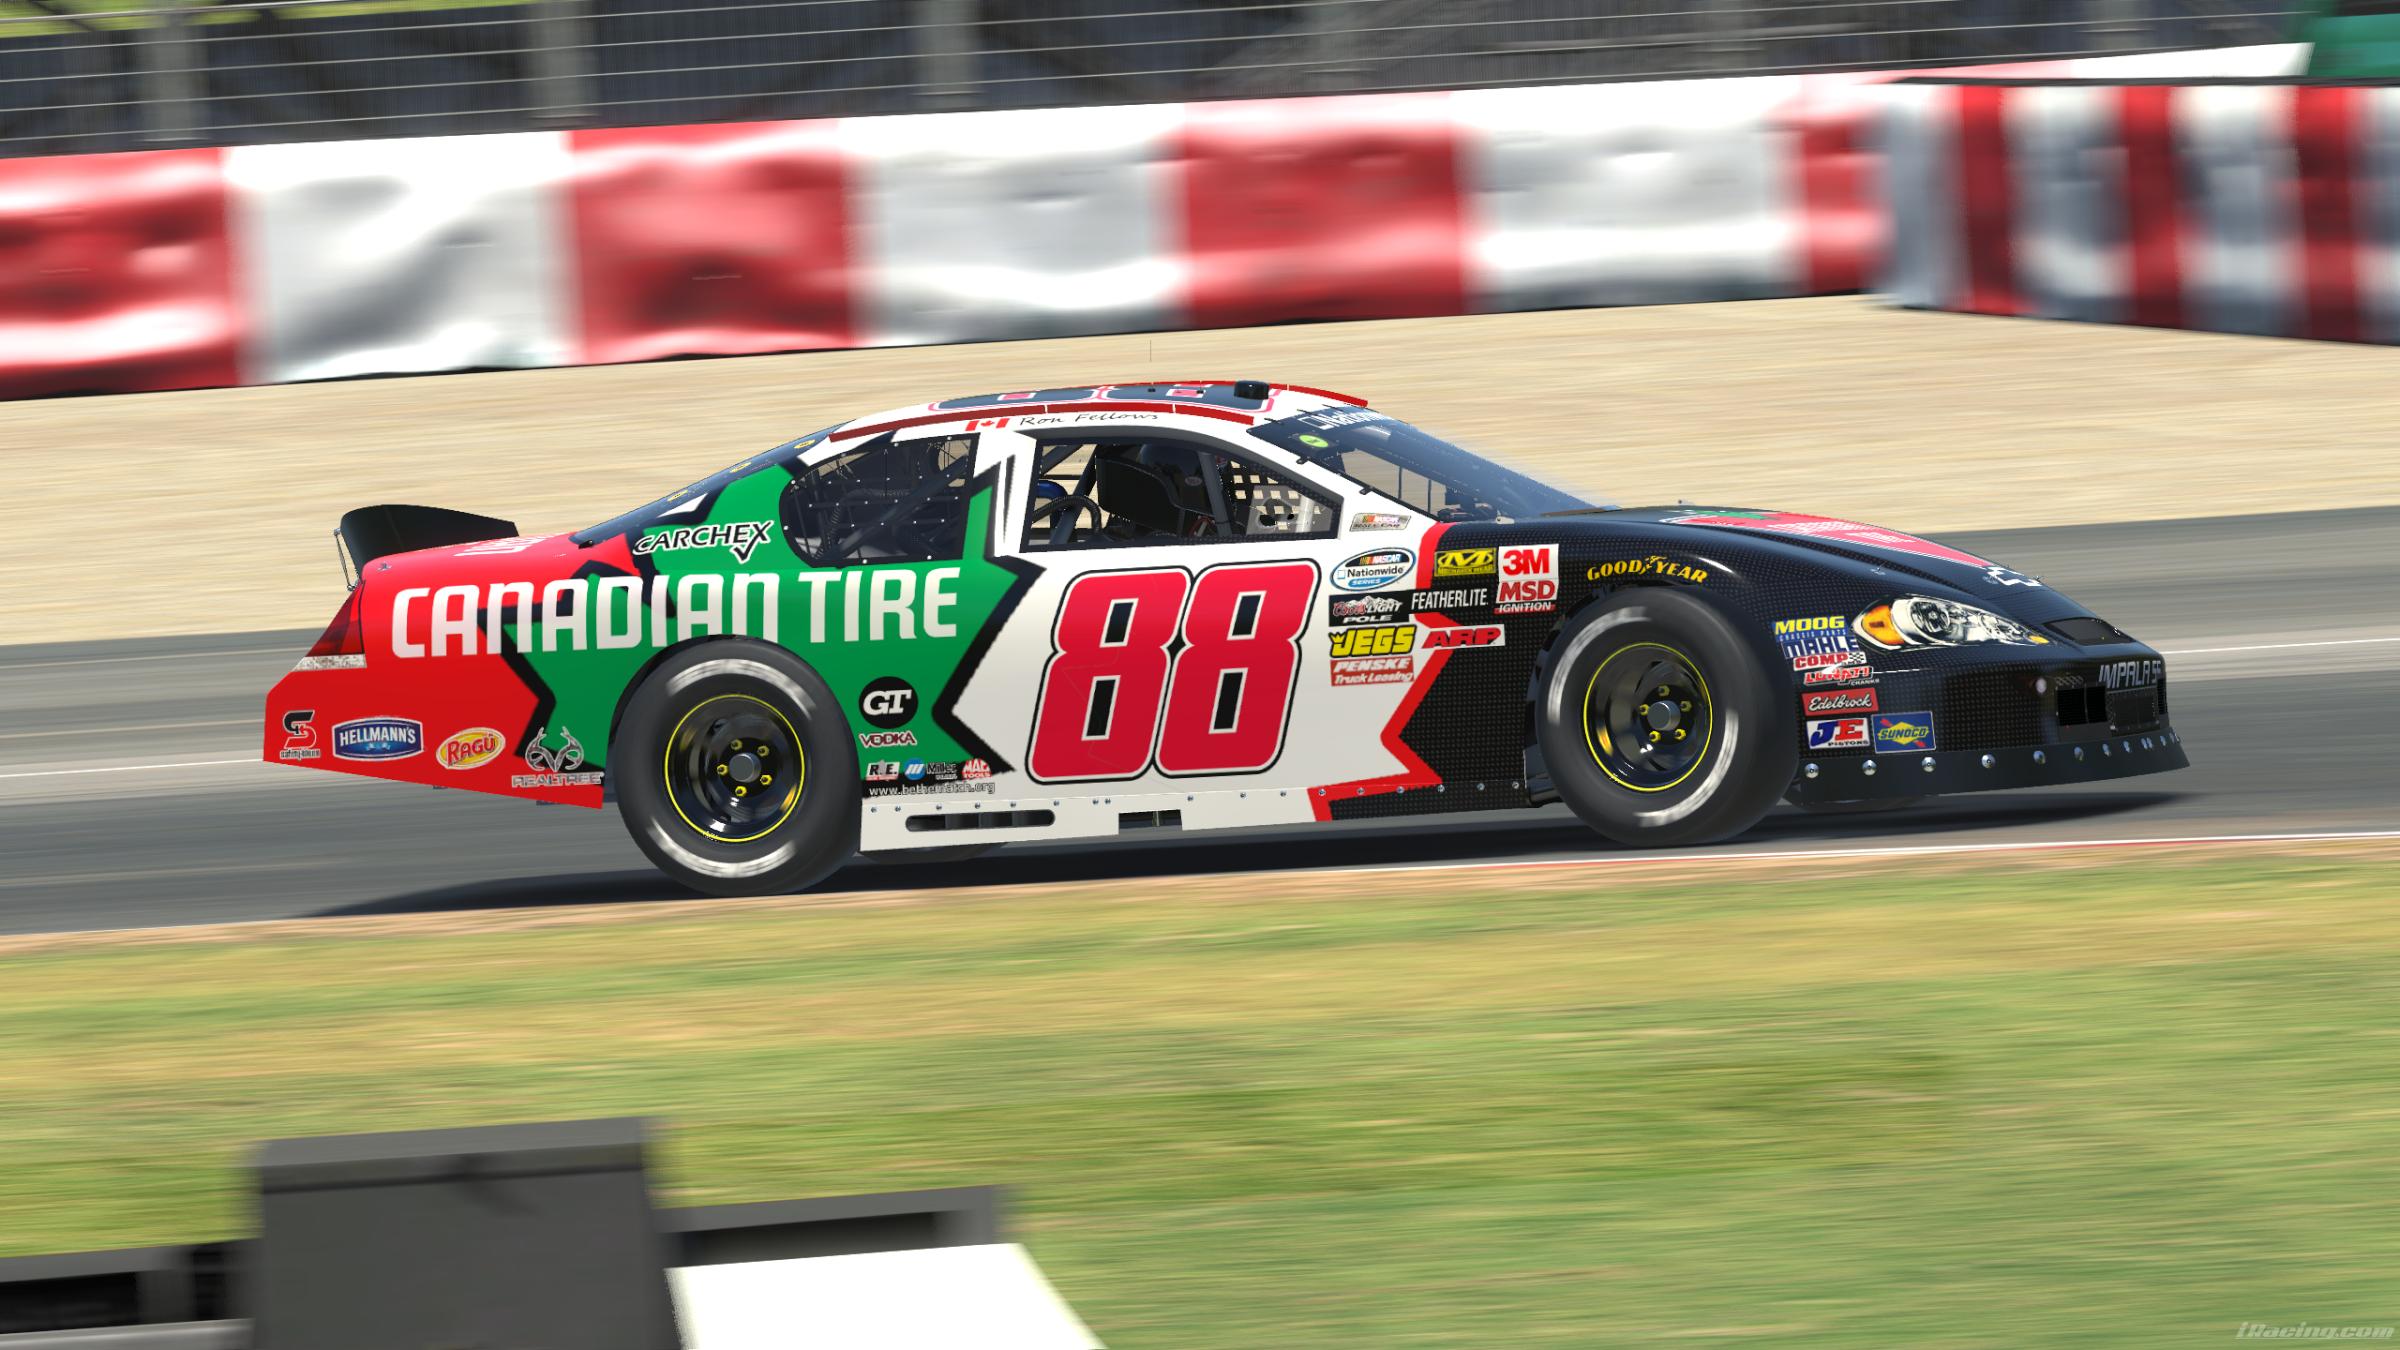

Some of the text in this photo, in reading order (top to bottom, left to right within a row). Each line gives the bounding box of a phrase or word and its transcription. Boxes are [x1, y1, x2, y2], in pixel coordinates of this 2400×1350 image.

[1019, 409, 1159, 427] Ron Fellows
[632, 520, 773, 563] CARCHEX
[1372, 553, 1402, 564] NASCAR
[1503, 548, 1550, 576] 3M
[1347, 566, 1404, 578] Nationwide
[1500, 580, 1555, 602] MSD
[391, 567, 961, 660] CANADIAN TIRE
[1500, 602, 1551, 613] IGNITION
[1343, 615, 1393, 624] POLE
[1775, 615, 1845, 635] MOOG
[1329, 625, 1418, 658] JEGS
[1421, 627, 1502, 648] ARP
[1782, 634, 1860, 659] MAHLE
[1333, 658, 1411, 673] PENSKE
[1794, 654, 1850, 670] COMP
[1025, 558, 1322, 786] 88
[1334, 670, 1414, 685] Truck Leasing
[2098, 660, 2151, 689] IMPALA
[863, 689, 913, 716] GT
[1808, 693, 1873, 711] Edelbrock
[339, 727, 417, 746] HELLMANN'S
[859, 731, 917, 748] VODKA
[1810, 719, 1864, 747] JE
[1878, 726, 1929, 741] SUNOCO
[964, 759, 992, 773] MAC
[512, 772, 602, 788] REALTREE
